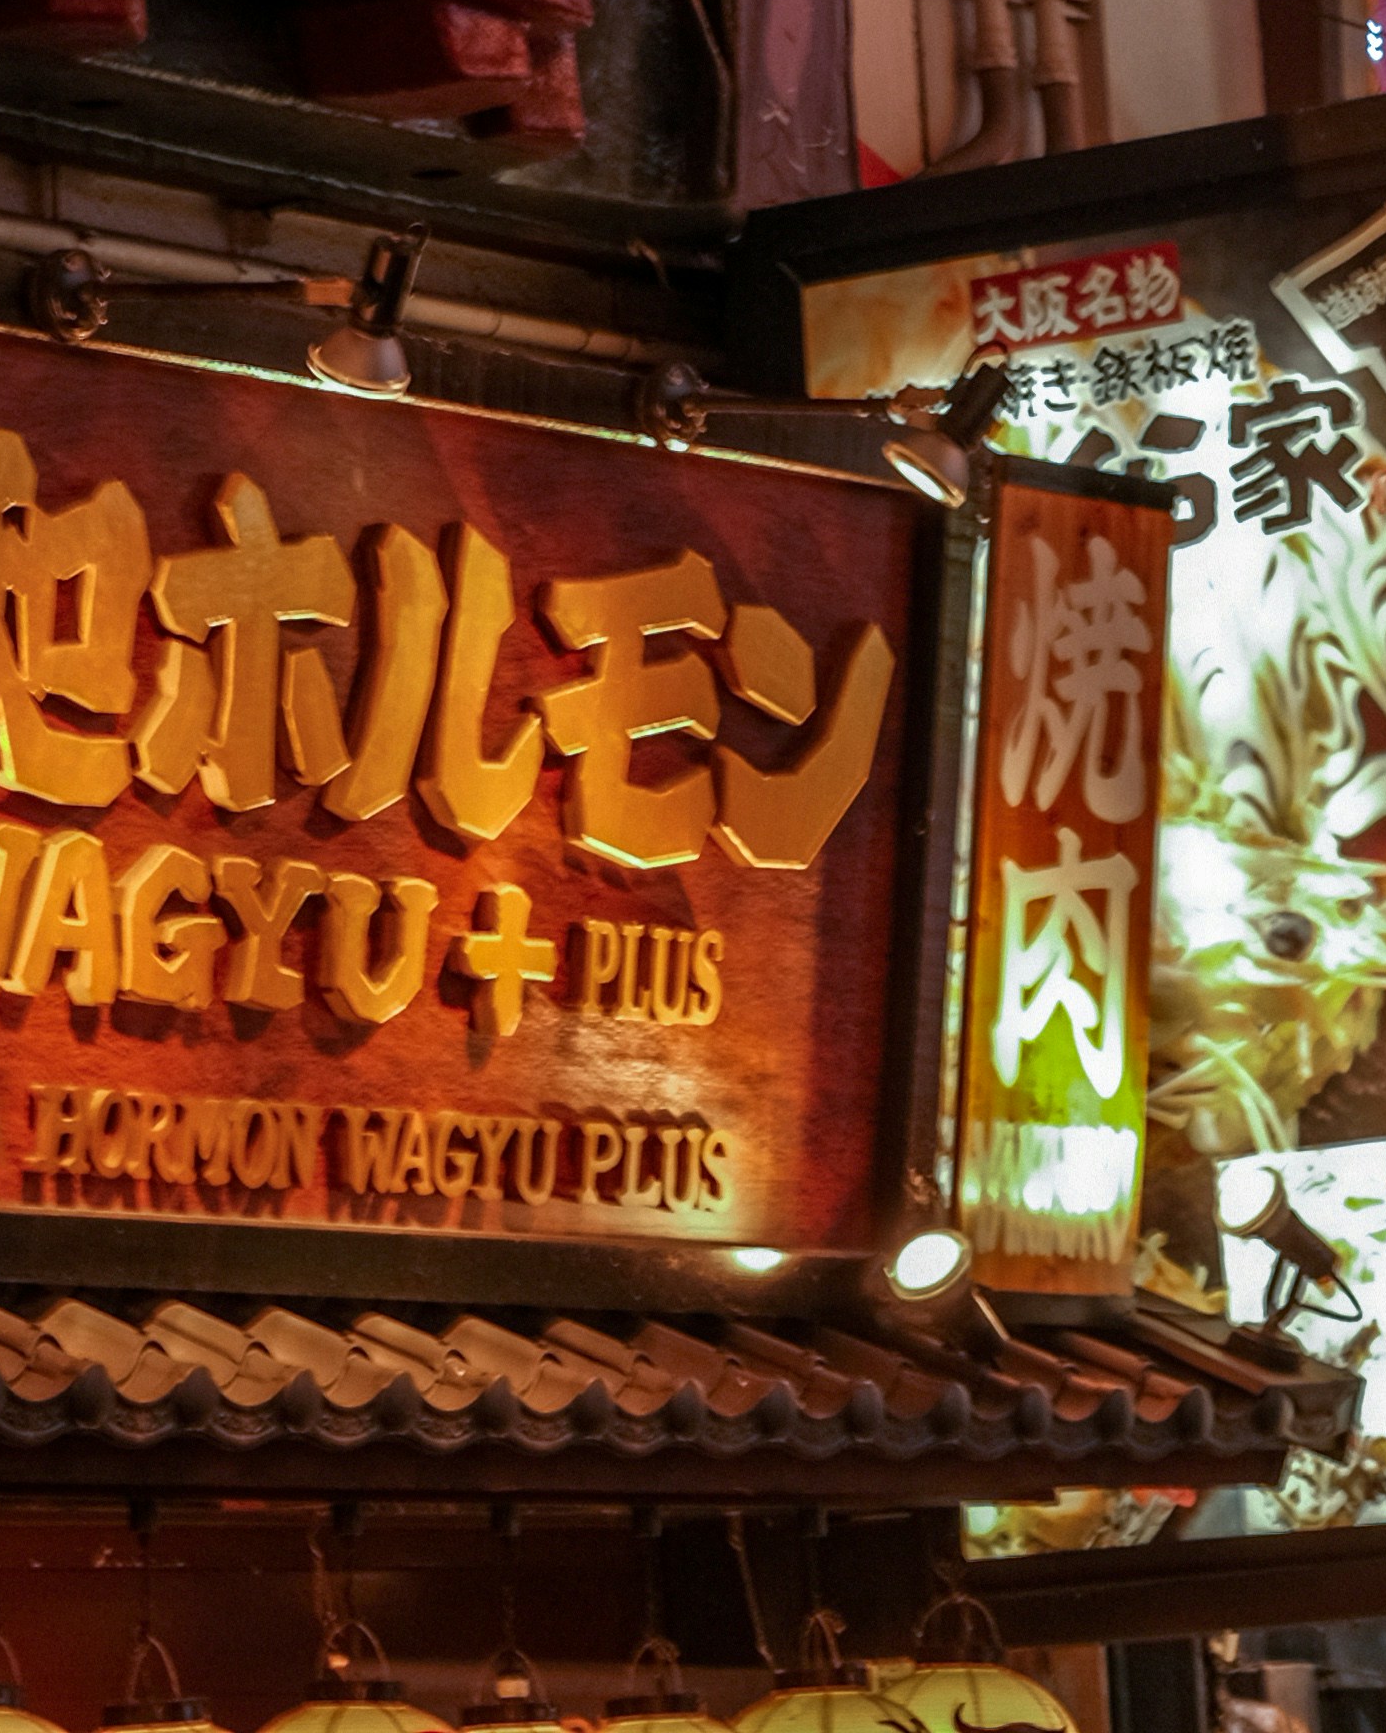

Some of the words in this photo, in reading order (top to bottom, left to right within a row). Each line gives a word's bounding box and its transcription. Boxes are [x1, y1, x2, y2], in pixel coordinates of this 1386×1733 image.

[975, 252, 1181, 344] 大阪名物
[992, 535, 1153, 1100] 焼肉
[582, 917, 725, 1027] PLUS
[24, 1084, 323, 1191] HORMON
[345, 1105, 562, 1207] WAGYU
[582, 1123, 737, 1215] PLUS
